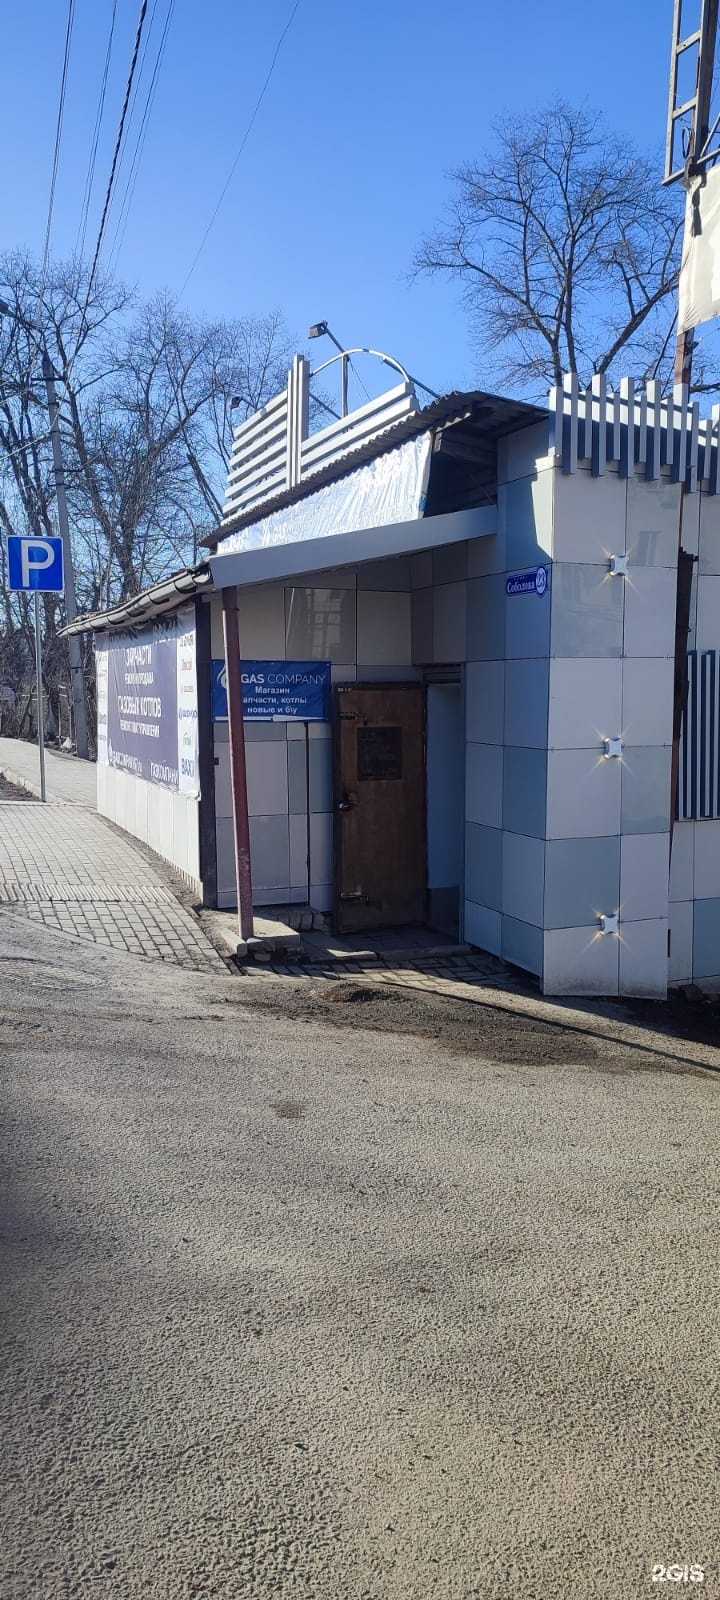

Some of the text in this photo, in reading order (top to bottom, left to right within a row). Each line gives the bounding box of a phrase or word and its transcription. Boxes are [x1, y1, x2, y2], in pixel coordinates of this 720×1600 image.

[21, 540, 55, 587] P
[240, 673, 326, 685] GAS COMPANY
[255, 685, 290, 694] Магазин
[242, 696, 307, 705] апчасти, котлы
